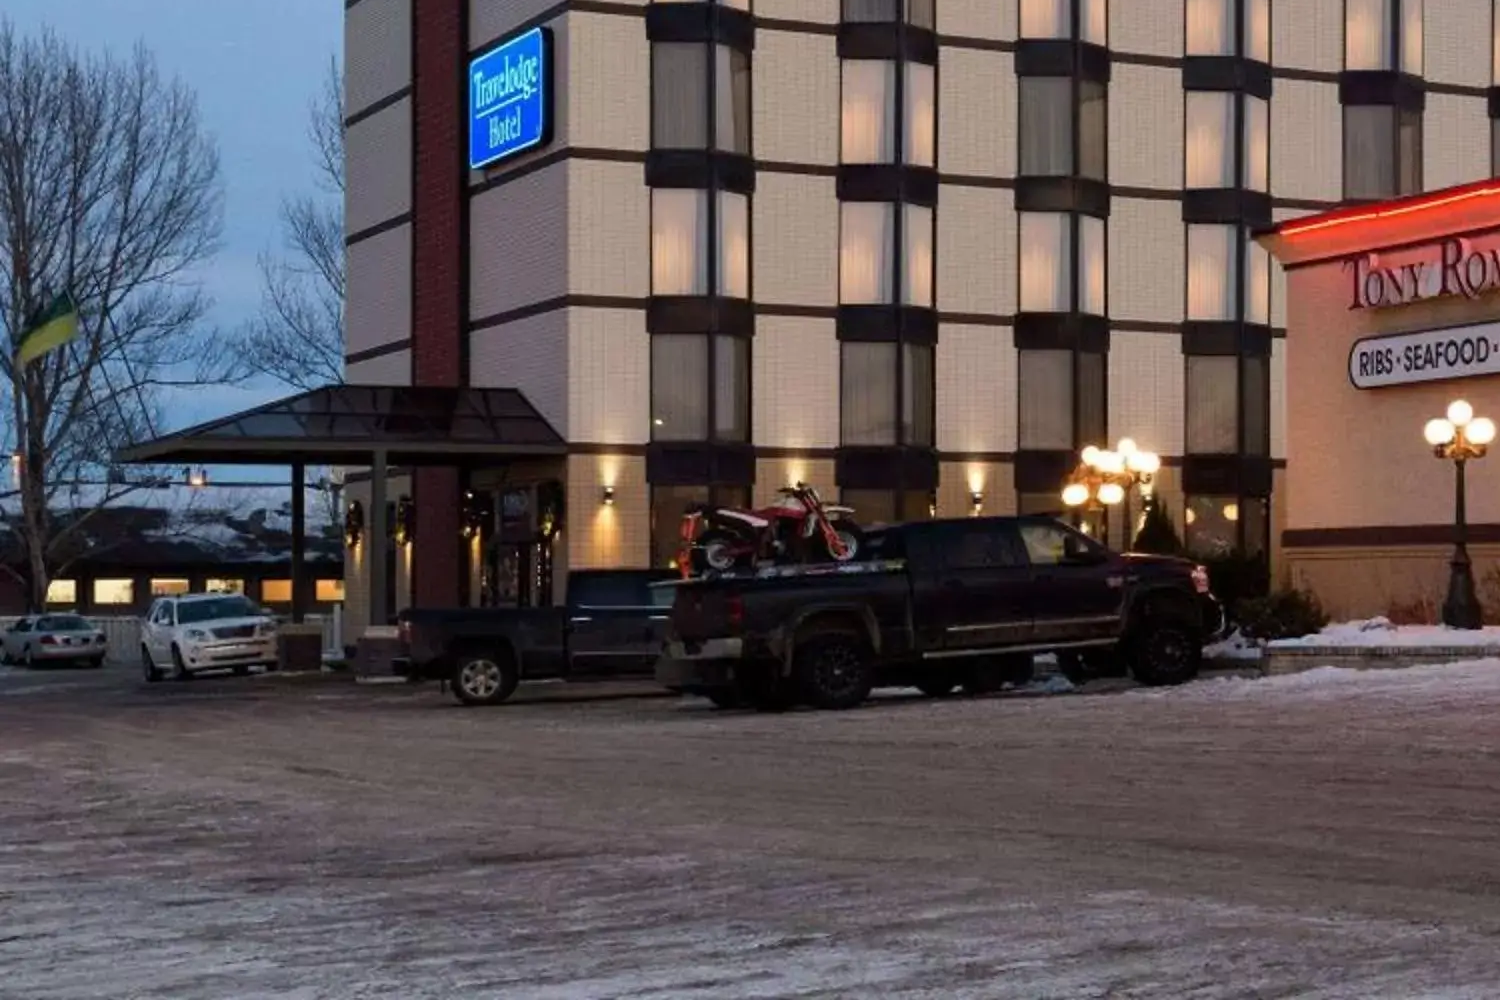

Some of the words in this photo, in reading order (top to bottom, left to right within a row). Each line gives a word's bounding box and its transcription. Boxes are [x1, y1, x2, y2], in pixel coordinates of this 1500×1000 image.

[474, 55, 538, 109] Travelodge
[488, 105, 522, 149] Hotel
[1344, 253, 1424, 310] TONY
[1359, 348, 1393, 377] RIBS
[1403, 336, 1489, 372] SEAFOOD
